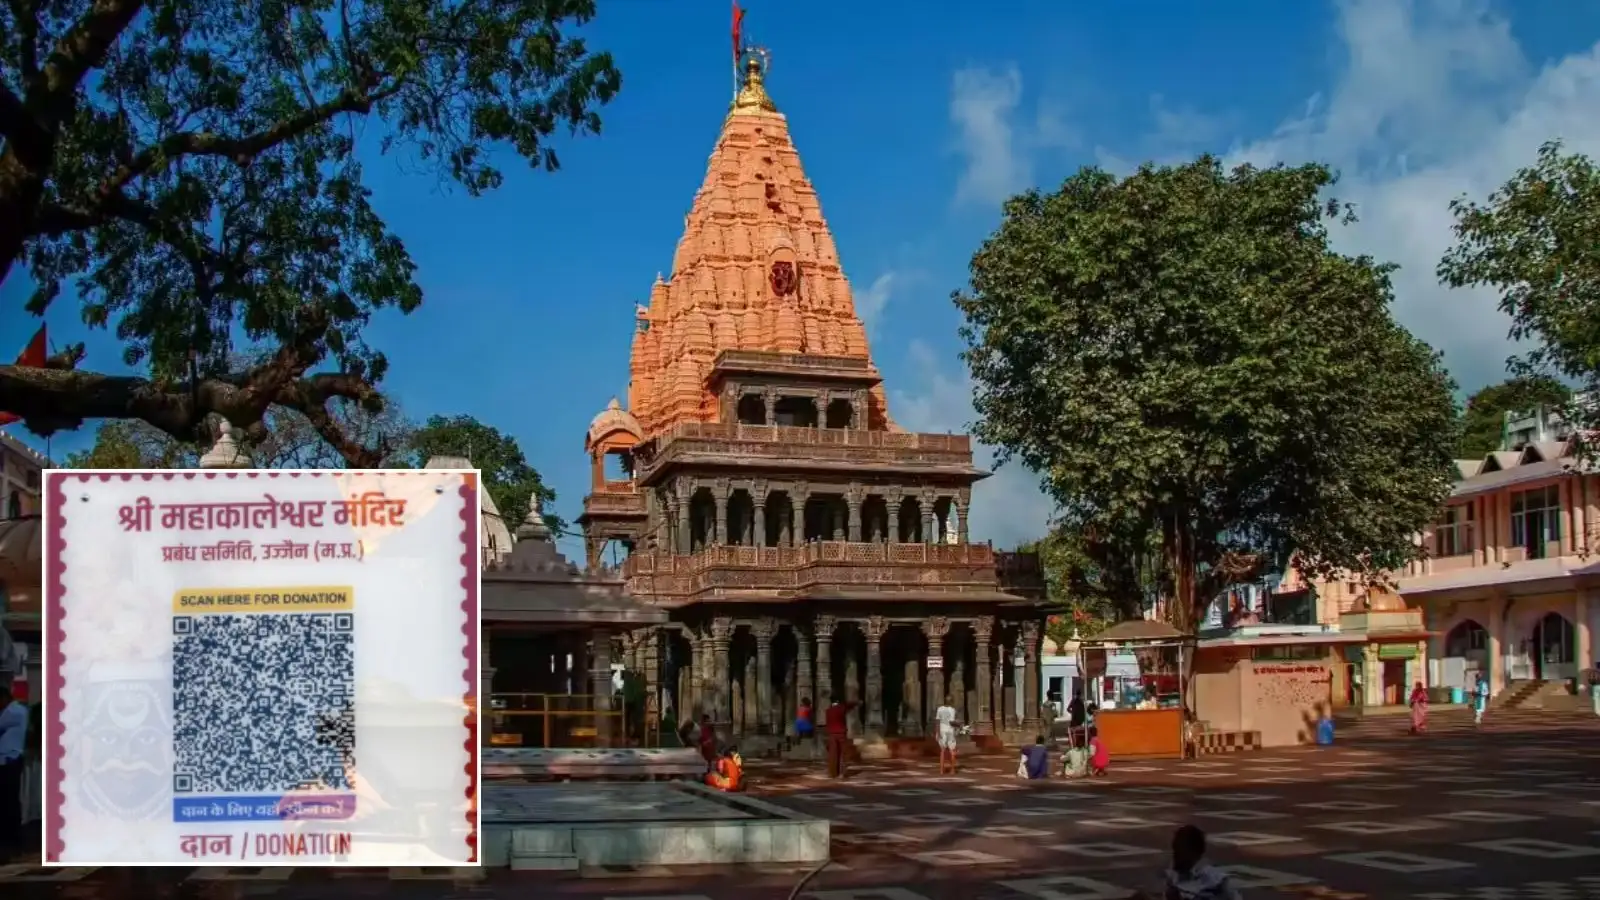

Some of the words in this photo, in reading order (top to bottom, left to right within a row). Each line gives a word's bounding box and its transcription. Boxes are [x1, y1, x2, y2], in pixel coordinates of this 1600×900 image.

[118, 496, 154, 532] श्री
[159, 494, 327, 529] महाकालेश्वर
[331, 492, 407, 527] मंदिर
[161, 543, 197, 562] प्रबंध
[200, 540, 257, 562] समिति,
[261, 540, 309, 560] उज्जैन
[314, 540, 365, 562] (म.प्र.)
[180, 595, 214, 607] SCAN
[217, 594, 250, 606] HERE
[254, 594, 279, 605] FOR
[283, 592, 347, 605] DONATION
[210, 802, 224, 816] के
[180, 834, 233, 858] दान
[240, 832, 248, 860] /
[256, 833, 352, 856] DONATION
